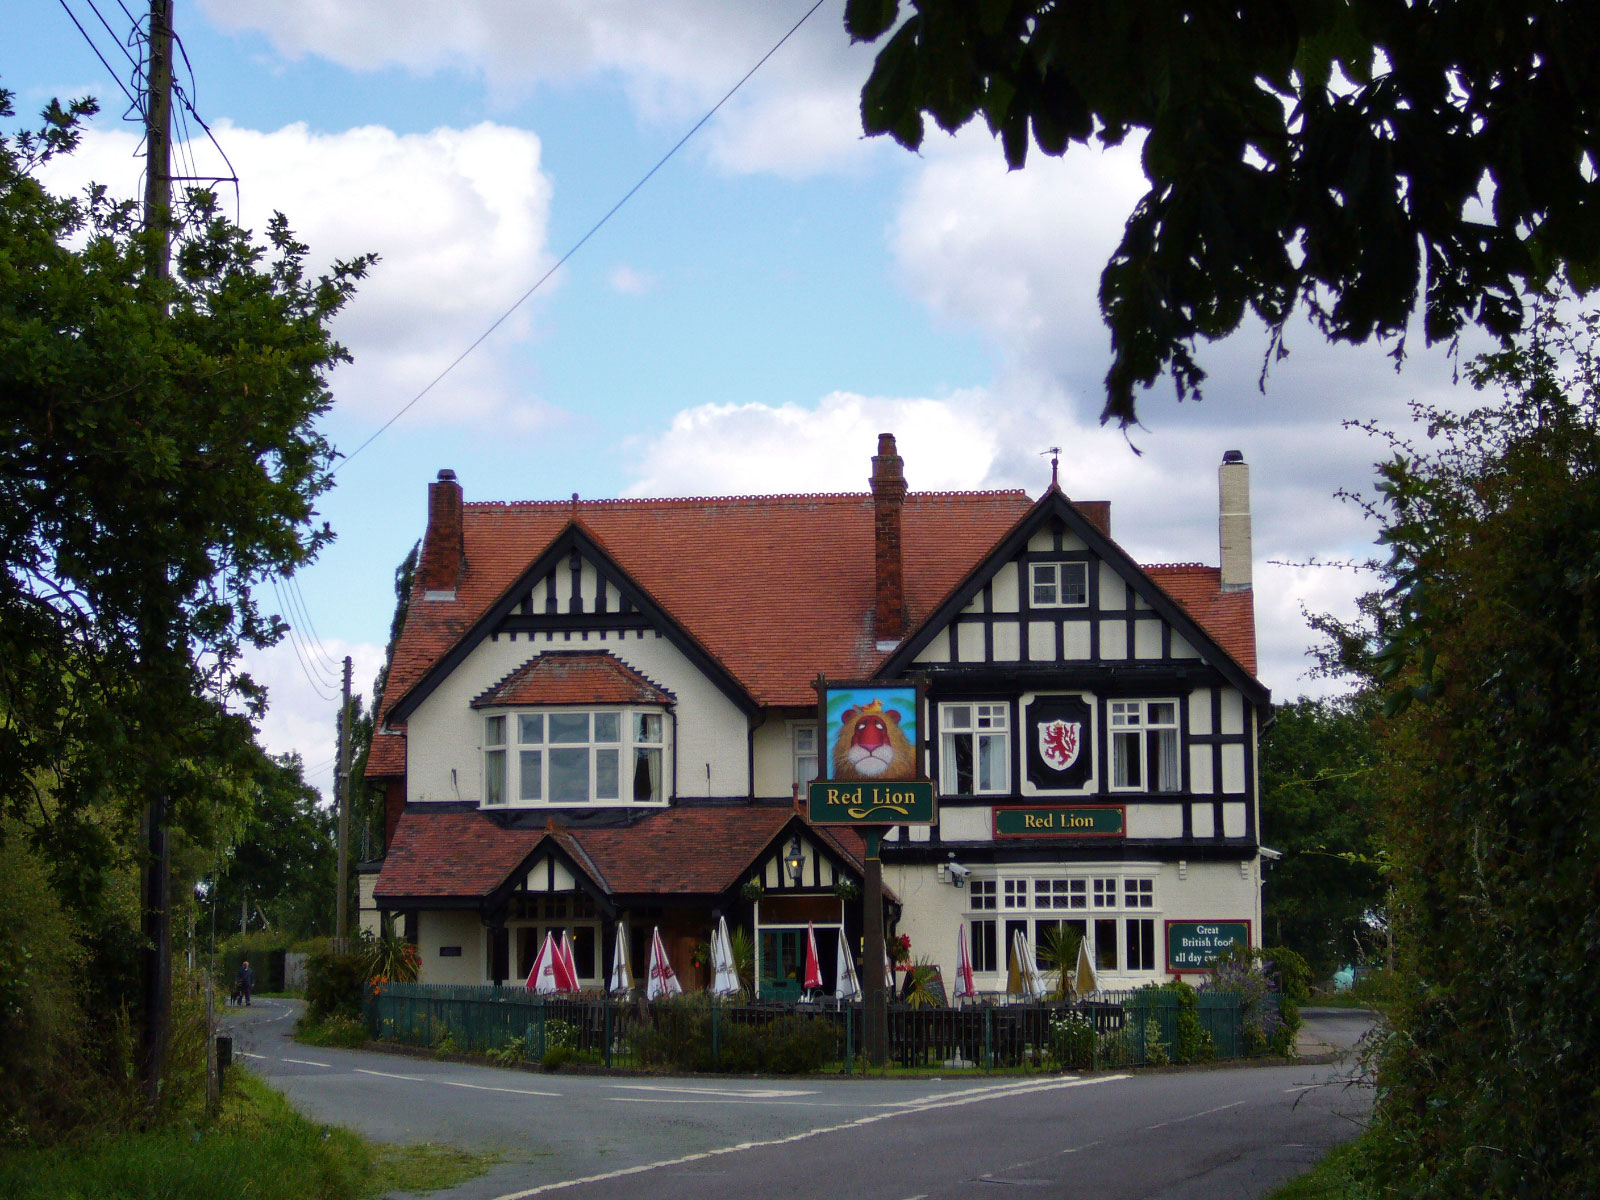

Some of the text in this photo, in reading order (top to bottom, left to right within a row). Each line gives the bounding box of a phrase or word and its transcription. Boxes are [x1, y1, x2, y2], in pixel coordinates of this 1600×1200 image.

[827, 788, 916, 805] Red Lion
[1024, 813, 1094, 828] Red Lion
[1196, 925, 1219, 934] Great
[1182, 937, 1211, 947] British
[1175, 952, 1186, 962] all
[1188, 952, 1202, 965] day
